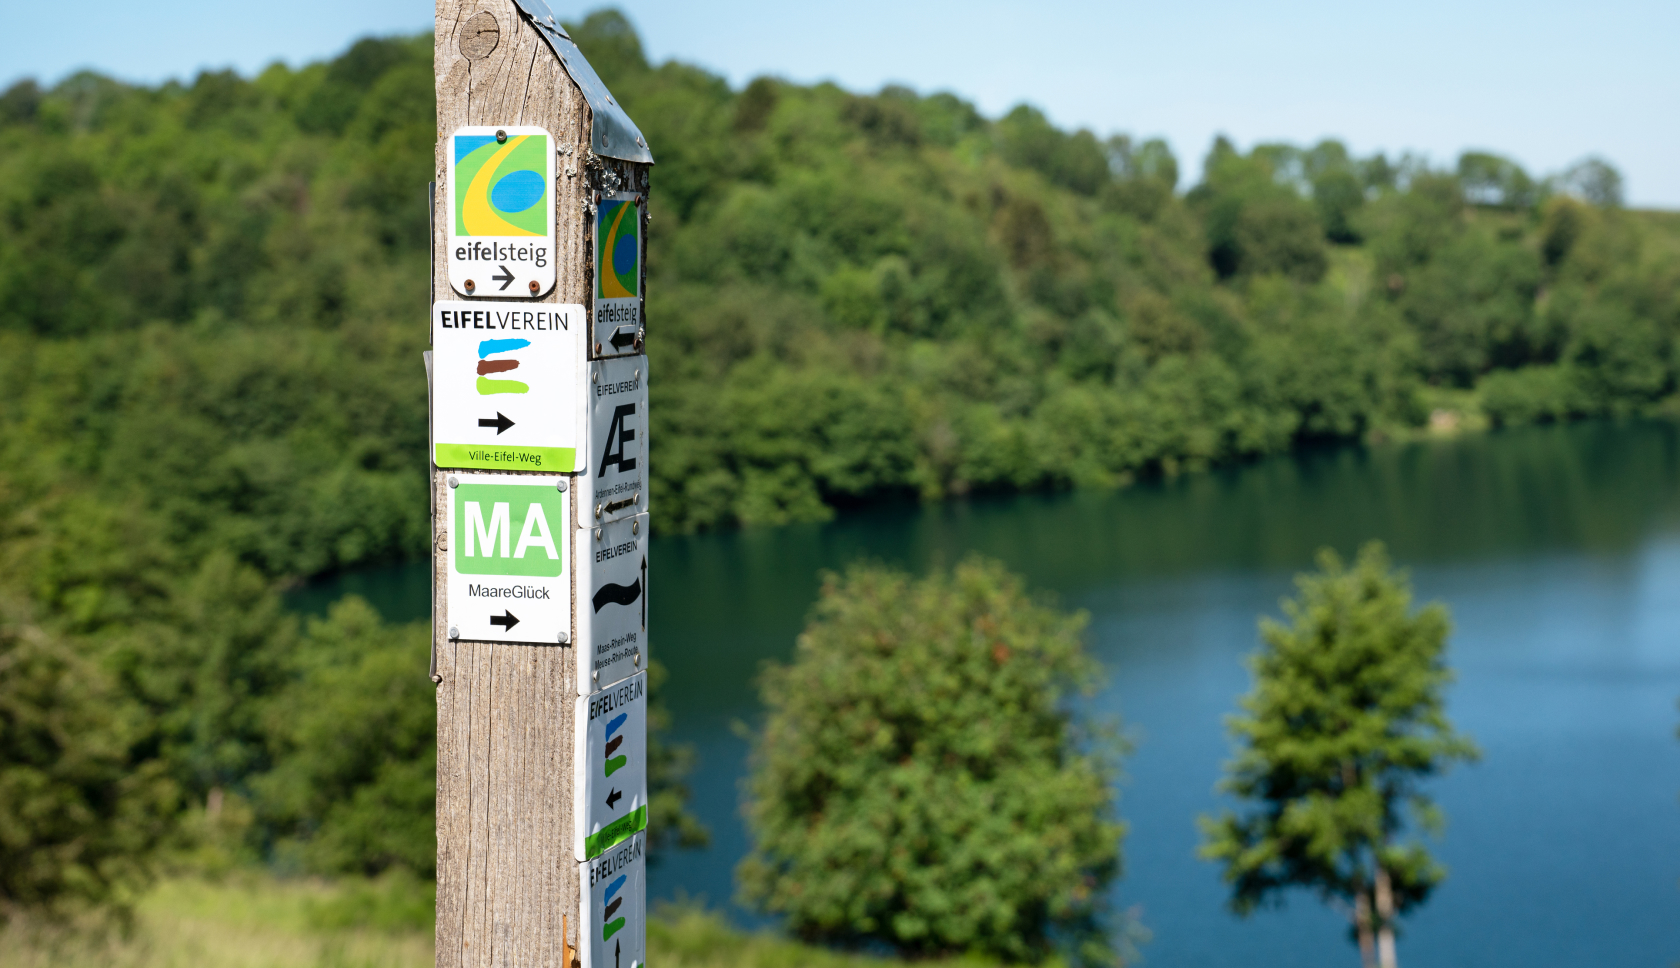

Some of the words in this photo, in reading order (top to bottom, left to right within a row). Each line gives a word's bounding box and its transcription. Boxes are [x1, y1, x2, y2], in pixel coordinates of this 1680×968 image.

[455, 241, 547, 267] eifelsteig
[441, 310, 568, 331] EIFELVEREIN
[597, 303, 637, 325] eifelsteig
[597, 379, 639, 397] EIFELVEREIN
[469, 451, 542, 466] Ville-Eifel-Weg
[464, 500, 559, 560] MA
[596, 540, 638, 563] EIFELVEREIN
[468, 583, 550, 600] MaareGlück
[597, 632, 637, 655] Maas-Rhein-Weg
[594, 645, 639, 670] Meuse-Rhin-Route
[590, 679, 643, 720] EIFELVEREIN
[590, 838, 641, 888] EFELVEREIN
